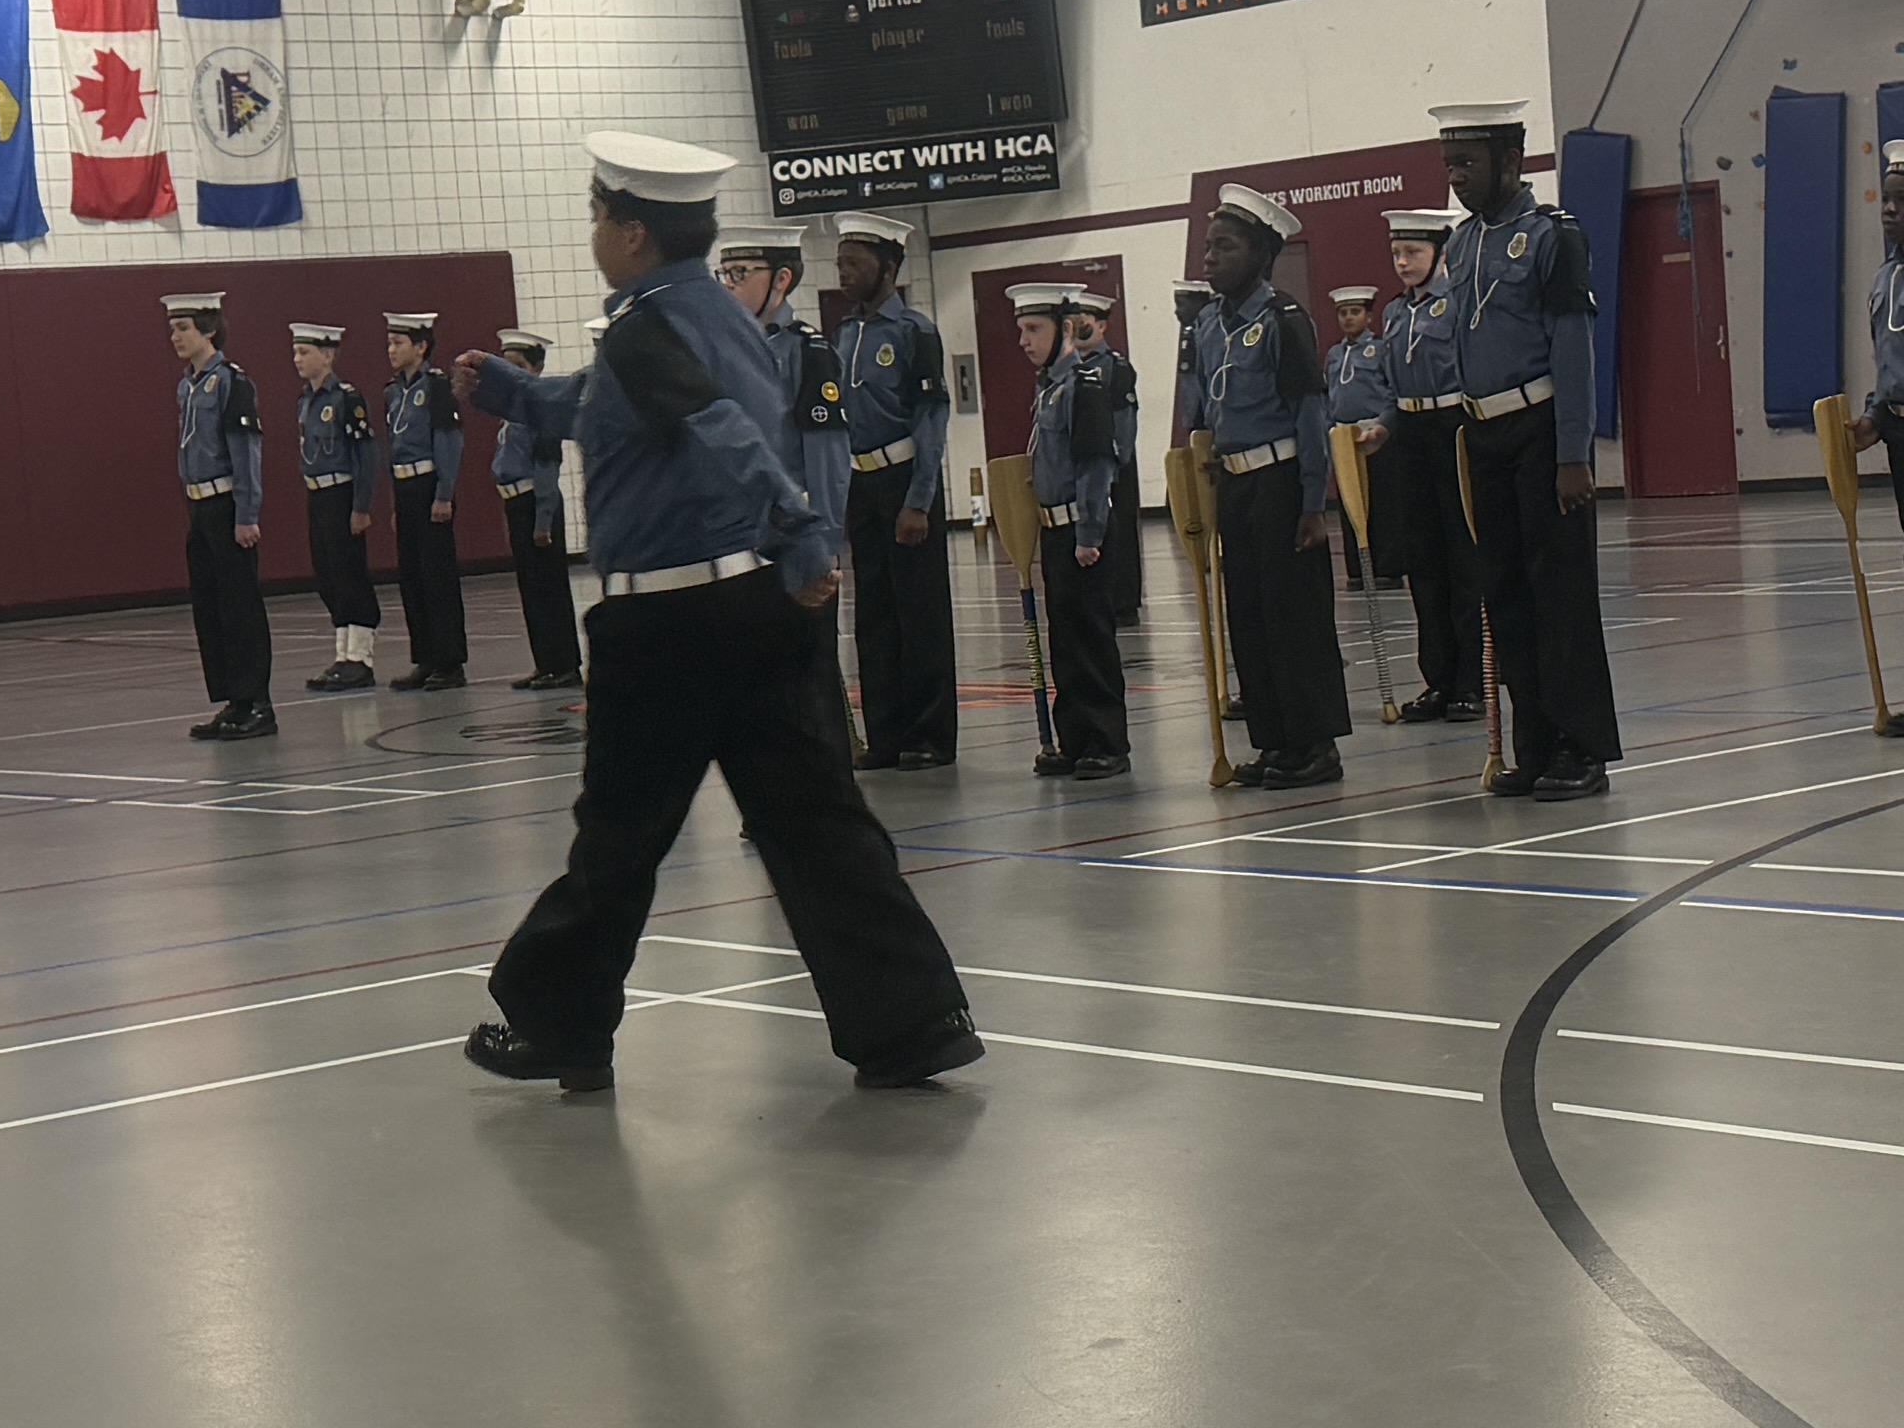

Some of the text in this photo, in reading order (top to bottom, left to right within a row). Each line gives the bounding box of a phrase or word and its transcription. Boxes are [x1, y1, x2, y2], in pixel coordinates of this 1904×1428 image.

[871, 27, 925, 51] player
[772, 133, 1056, 183] CONNECT WITH HCA
[1289, 180, 1361, 205] WORKOUT
[1363, 175, 1404, 196] ROOM
